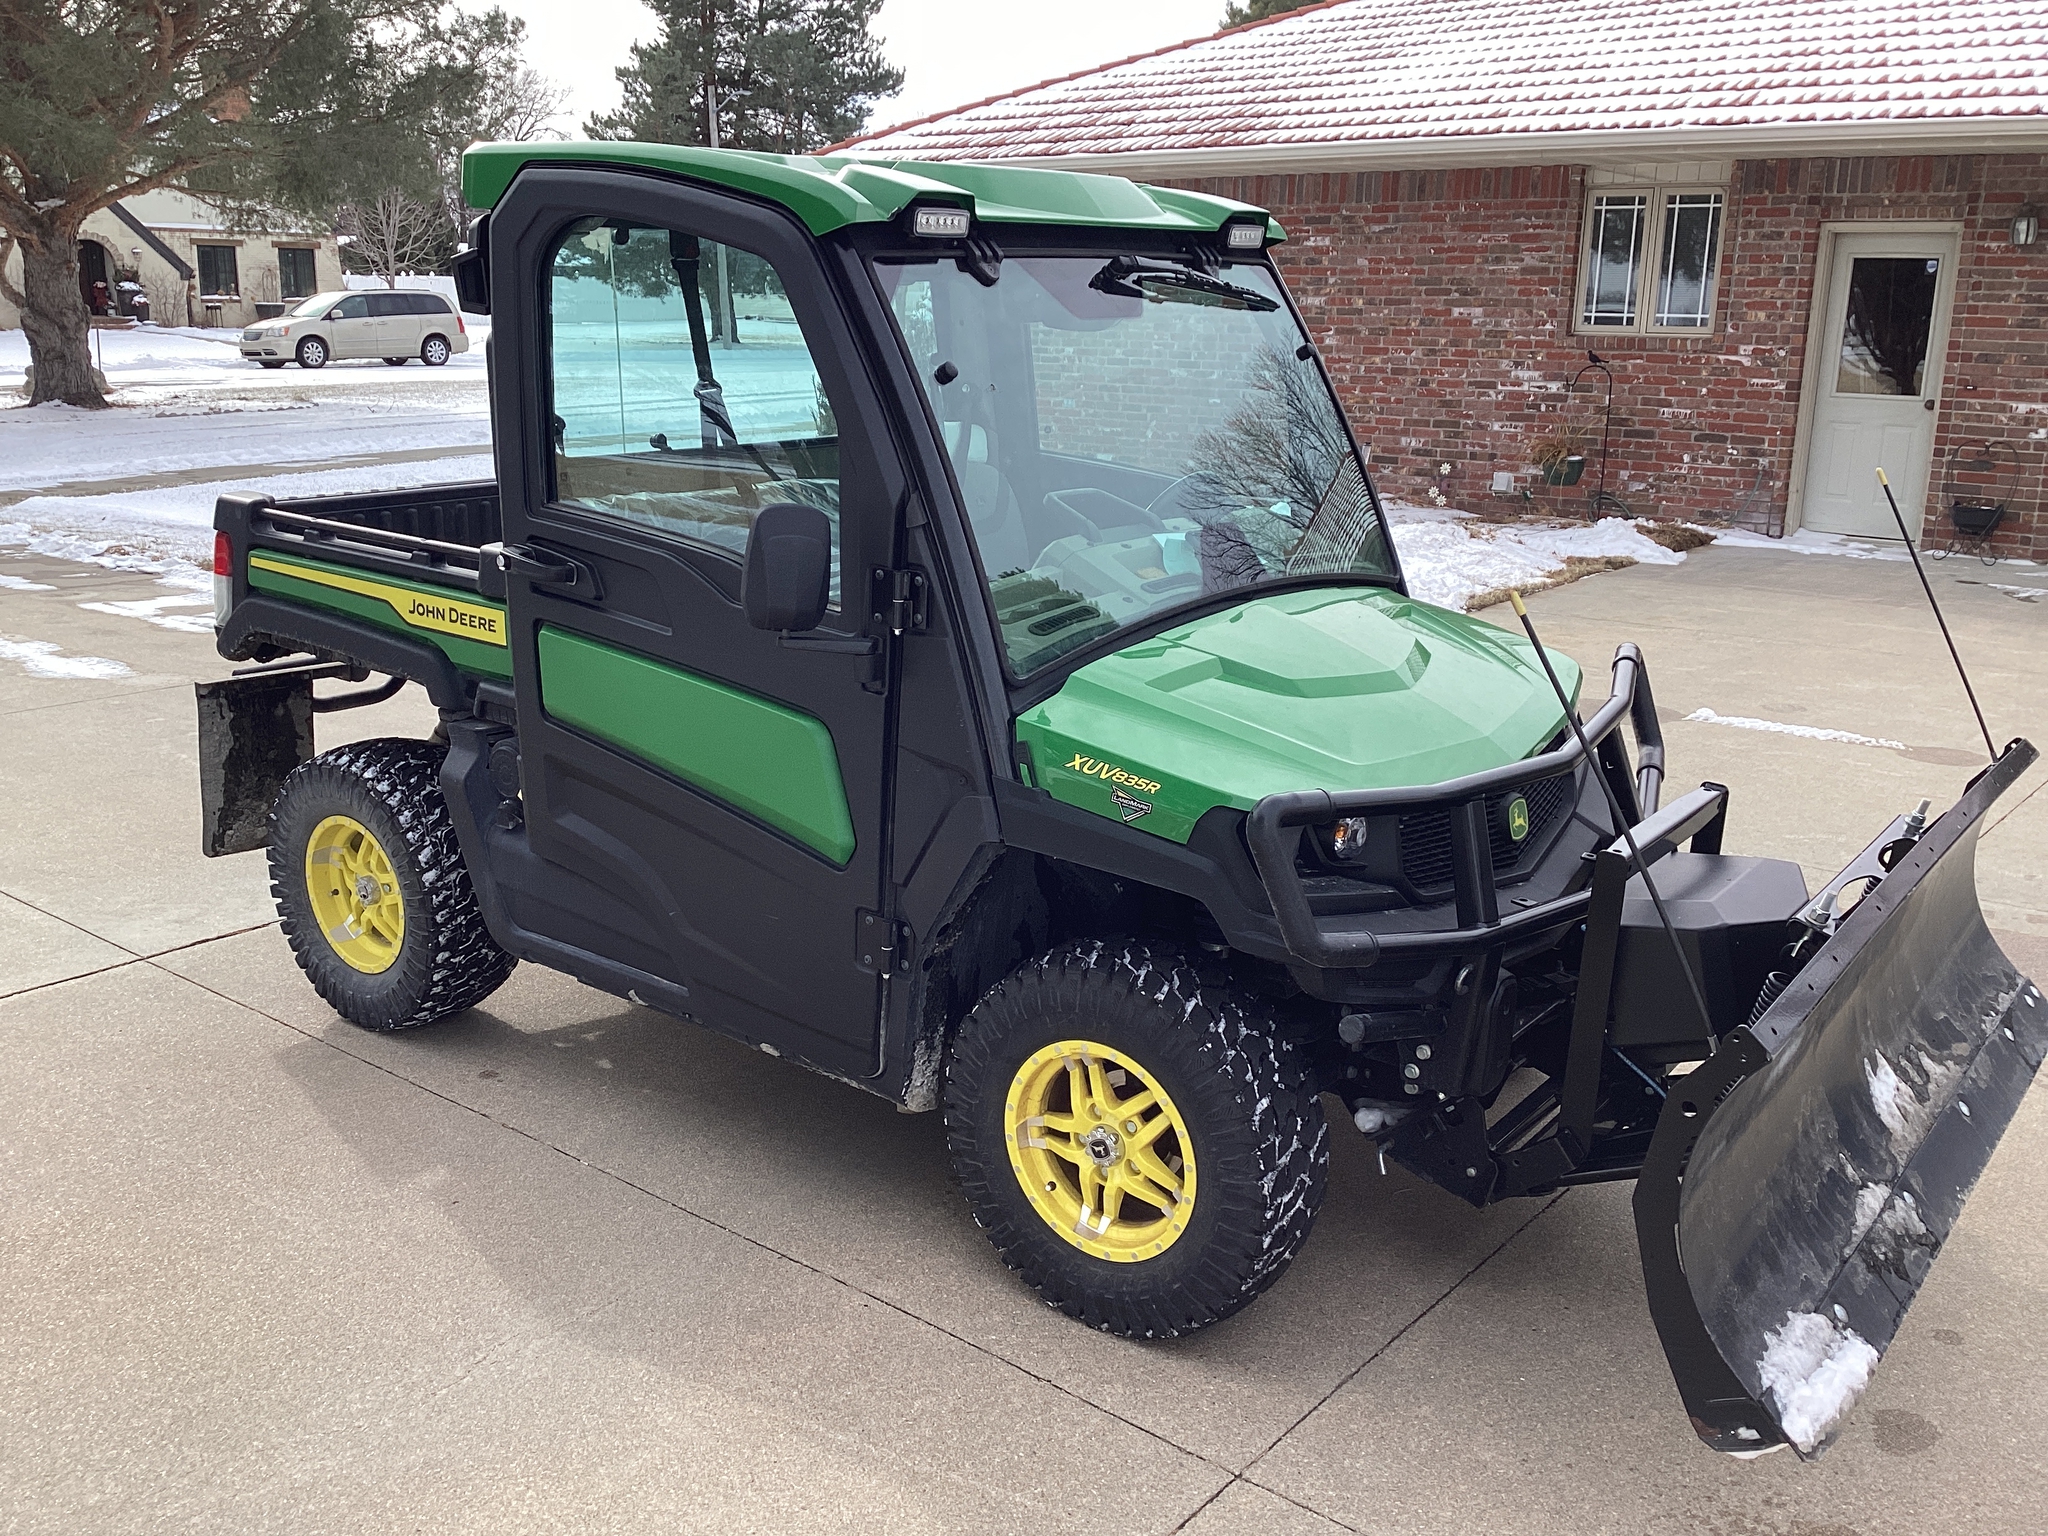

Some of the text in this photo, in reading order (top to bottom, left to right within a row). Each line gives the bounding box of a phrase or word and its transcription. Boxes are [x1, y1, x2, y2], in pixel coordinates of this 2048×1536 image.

[408, 599, 497, 633] JOHN DEERE
[1063, 753, 1162, 795] XUV835R
[1113, 795, 1150, 811] LANDMARK
